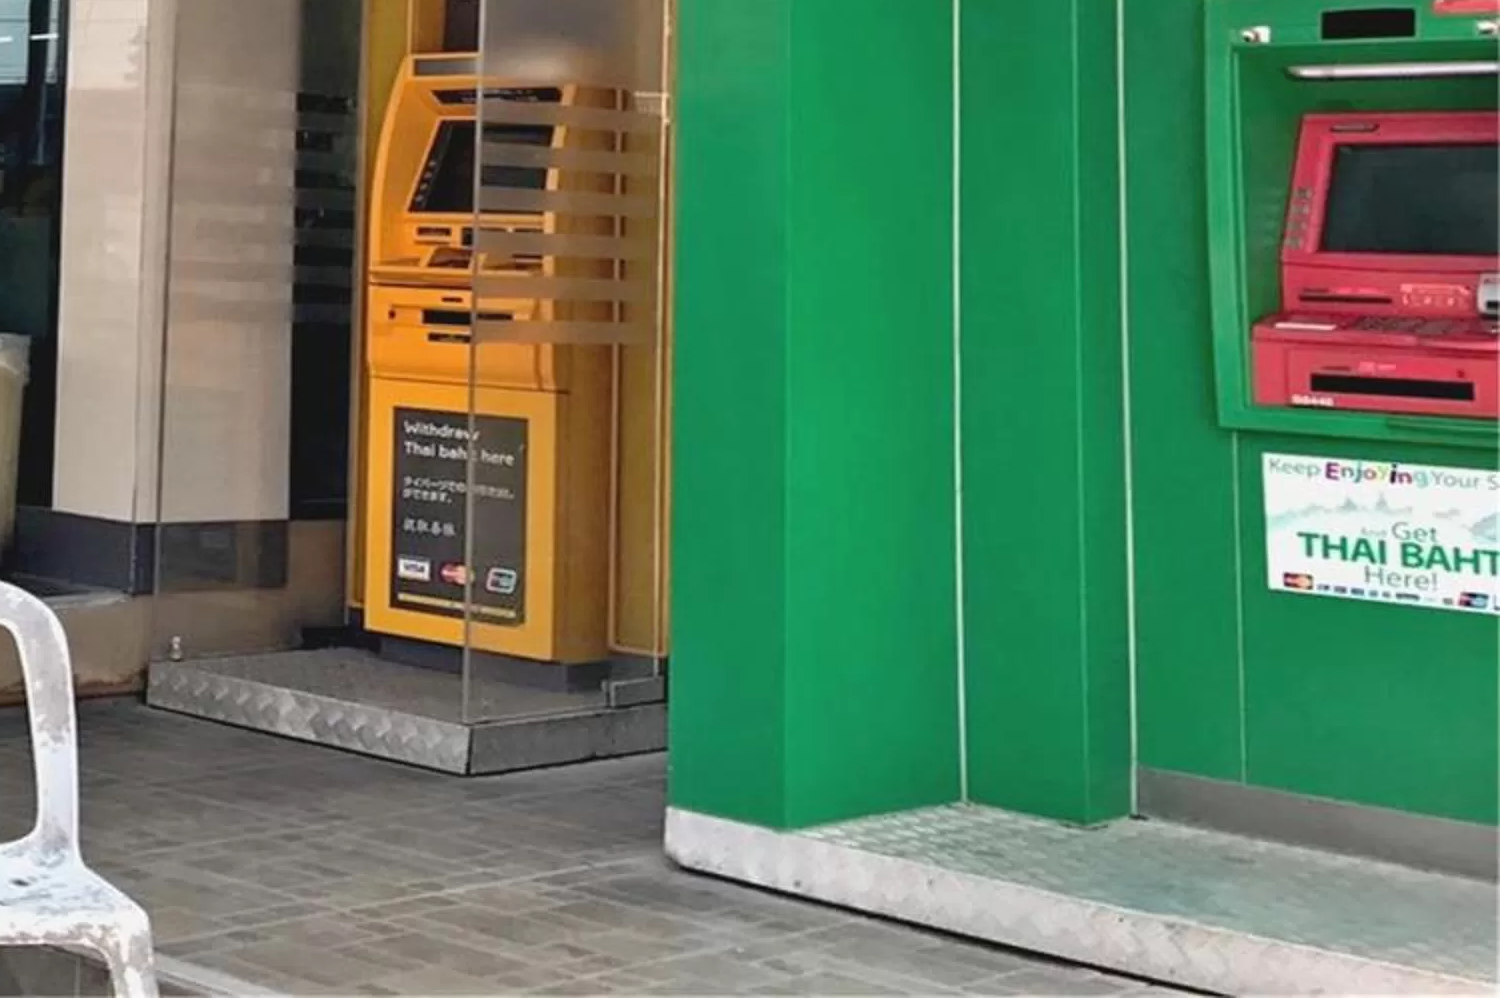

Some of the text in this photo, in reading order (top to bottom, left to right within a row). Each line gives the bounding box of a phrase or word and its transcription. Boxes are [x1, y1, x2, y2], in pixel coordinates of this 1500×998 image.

[404, 440, 436, 458] Thai
[1268, 458, 1321, 477] Keep
[1431, 471, 1480, 490] Your
[1391, 521, 1438, 543] Get
[1297, 531, 1499, 577] THAI BAHT
[1364, 565, 1439, 591] Here!
